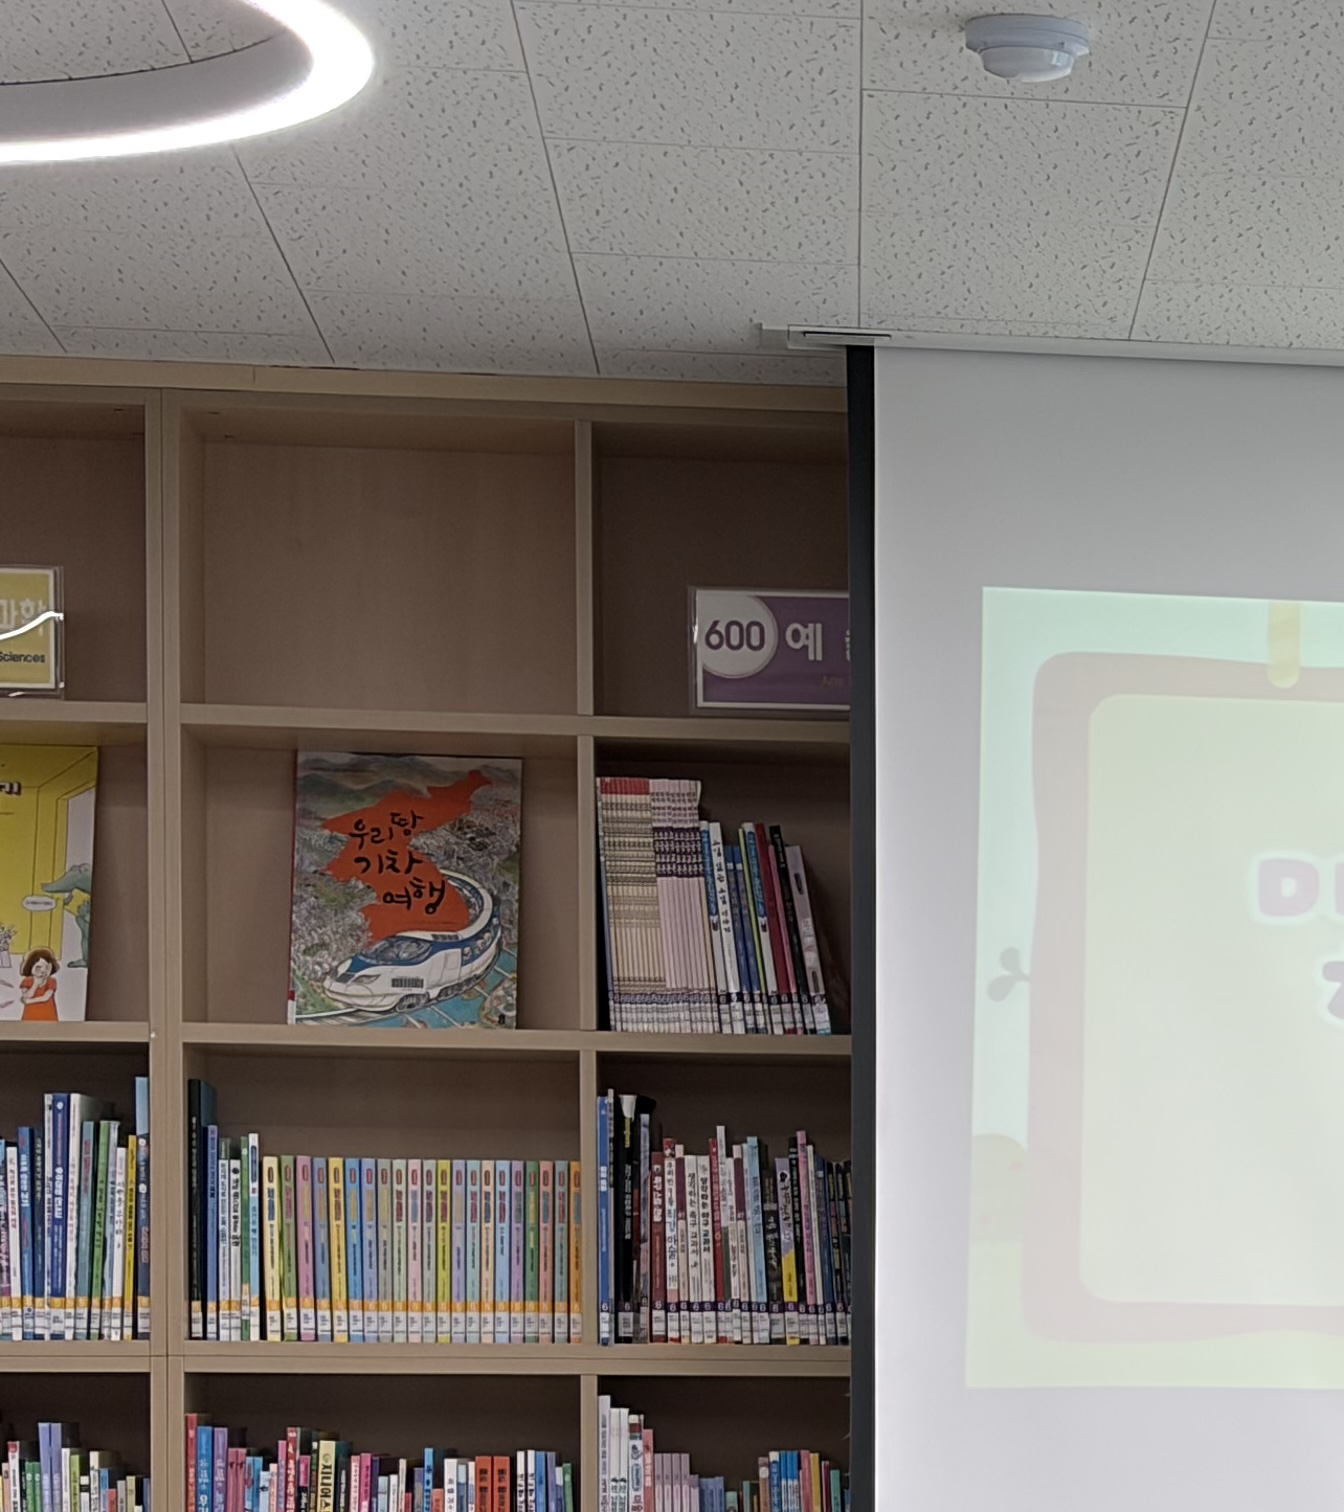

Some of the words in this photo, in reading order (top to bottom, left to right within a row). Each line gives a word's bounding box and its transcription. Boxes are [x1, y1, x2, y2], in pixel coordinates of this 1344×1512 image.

[705, 620, 765, 651] 600
[785, 622, 823, 661] 예
[354, 849, 423, 875] 기차
[382, 879, 446, 916] 여행
